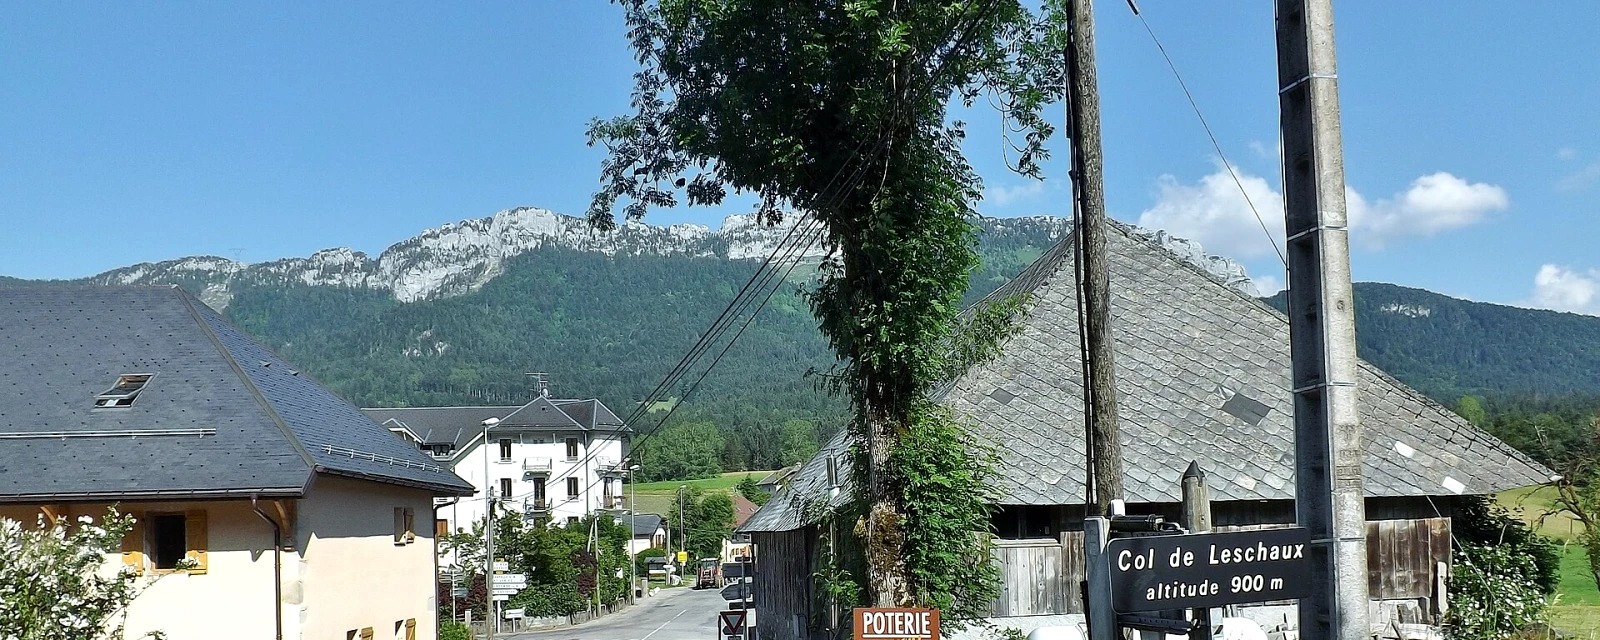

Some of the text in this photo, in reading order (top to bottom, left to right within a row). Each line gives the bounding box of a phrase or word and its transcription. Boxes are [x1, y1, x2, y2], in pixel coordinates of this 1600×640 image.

[1118, 541, 1304, 572] Col de Leschaux
[1146, 574, 1283, 600] altitude 900 m
[862, 611, 931, 634] POTERIE
